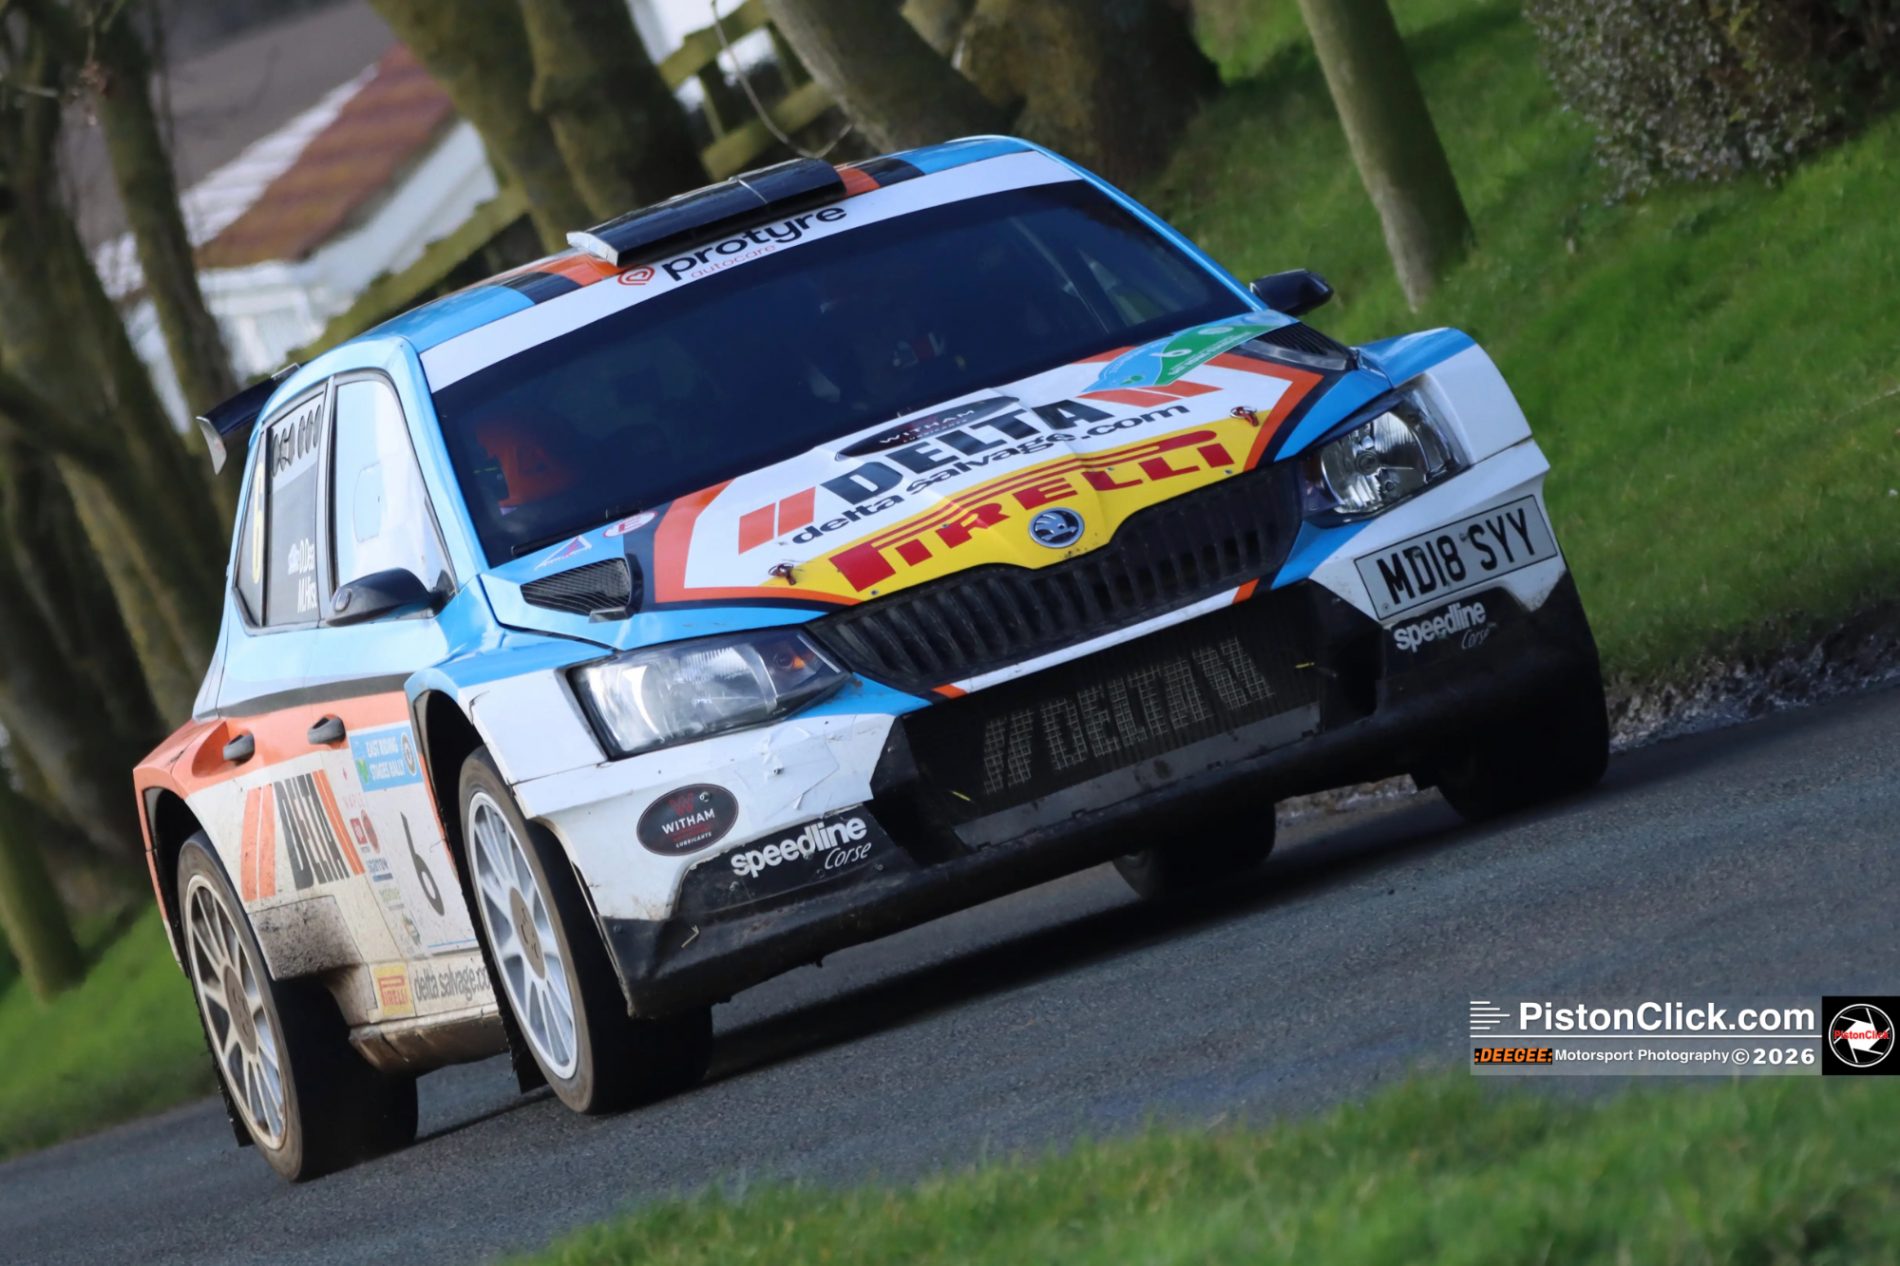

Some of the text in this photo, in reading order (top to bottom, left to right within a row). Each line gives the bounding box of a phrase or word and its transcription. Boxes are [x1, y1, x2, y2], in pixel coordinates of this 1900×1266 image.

[662, 207, 847, 281] protyre
[691, 244, 776, 279] autocare
[820, 399, 1115, 505] DELTA
[879, 409, 974, 444] WITHAM
[792, 405, 1190, 545] delta salvage.com
[829, 430, 1234, 592] PIRELLI
[1377, 508, 1536, 605] MD18 SYY
[1394, 601, 1487, 652] speedline
[1461, 622, 1496, 650] Corse
[274, 773, 350, 890] DELTA
[661, 808, 715, 835] WITHAM
[731, 817, 867, 878] speedline
[401, 811, 445, 916] 6
[824, 841, 872, 870] Corse
[415, 964, 438, 1001] delta
